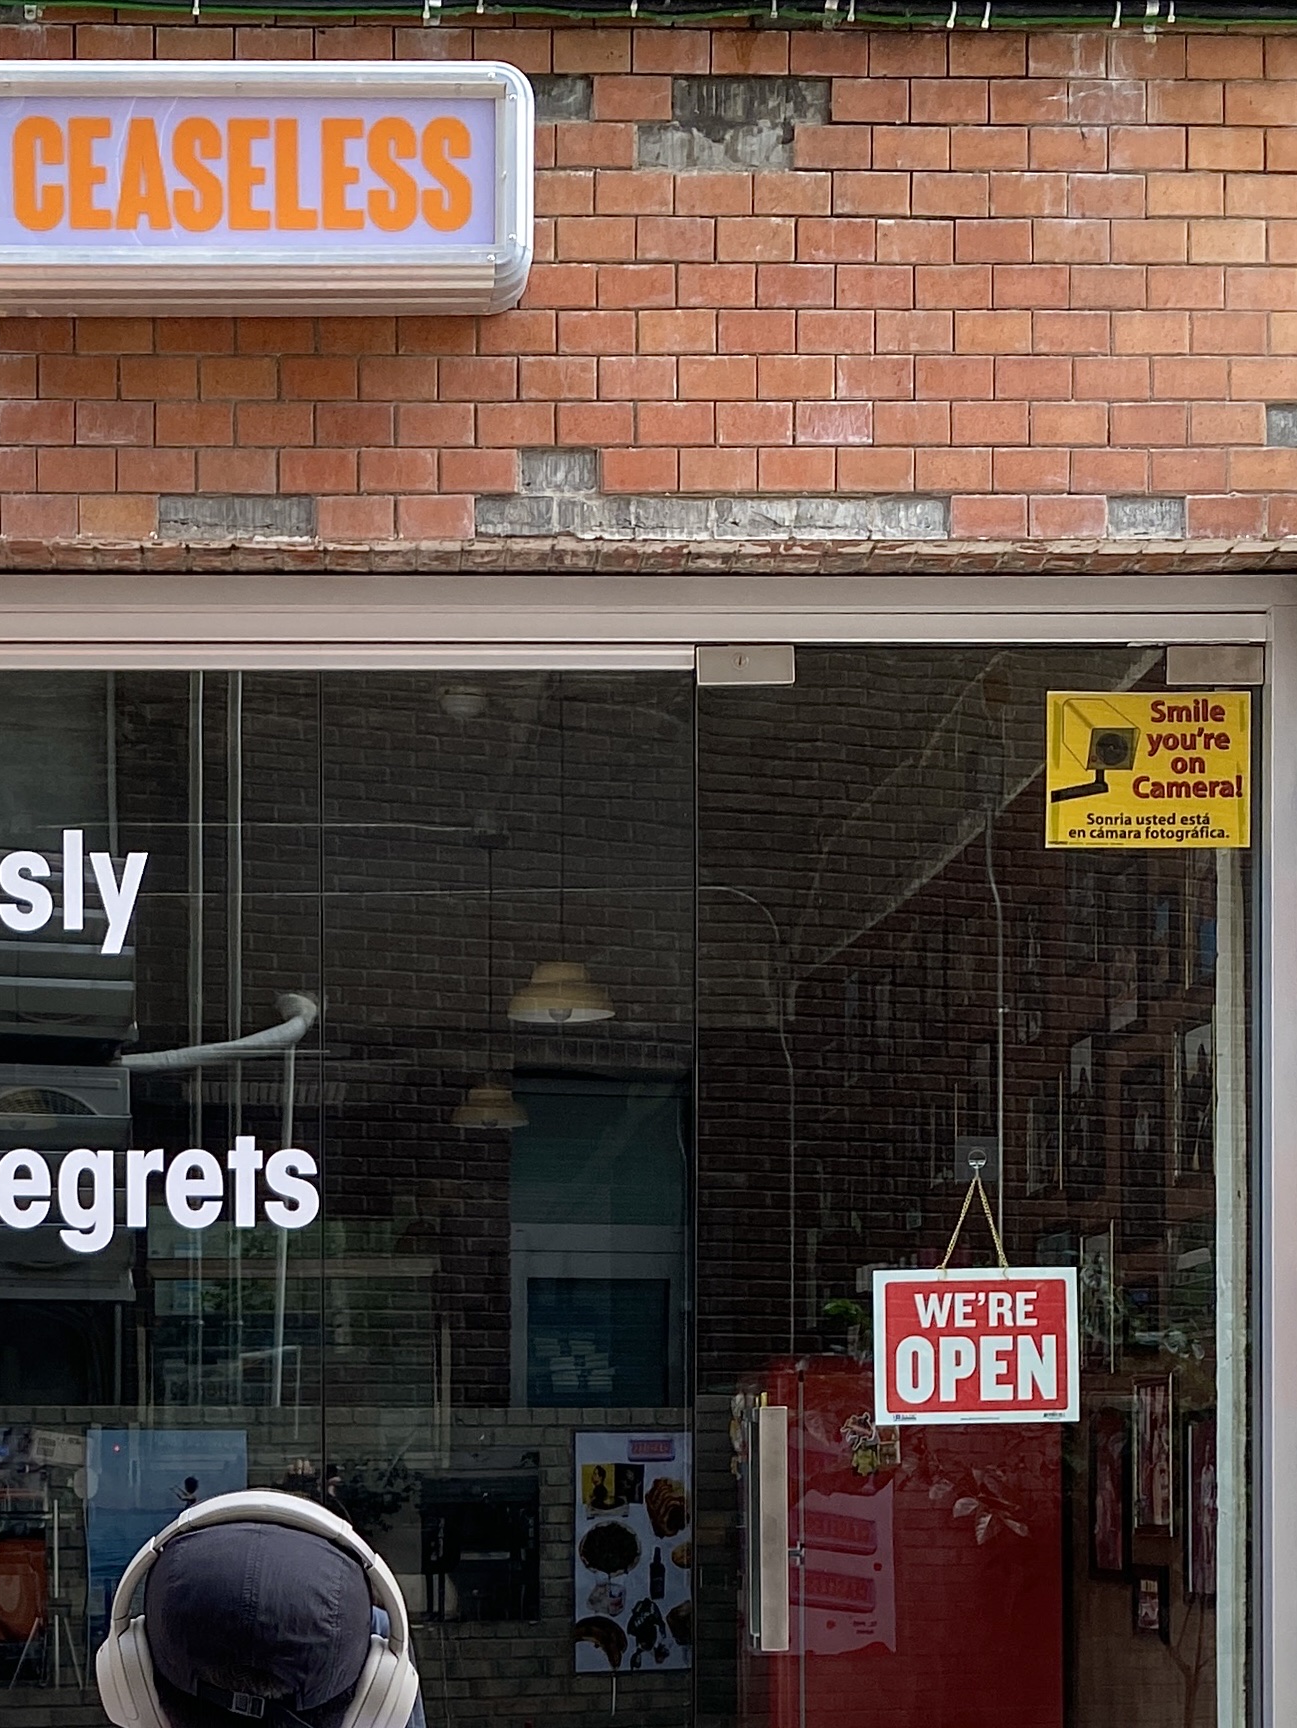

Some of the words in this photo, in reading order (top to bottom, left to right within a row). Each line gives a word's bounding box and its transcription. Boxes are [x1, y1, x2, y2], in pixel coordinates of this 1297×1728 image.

[12, 116, 473, 231] CEASELESS
[1150, 699, 1226, 723] Smile
[1146, 727, 1231, 757] you're
[1170, 757, 1206, 774] on
[1132, 775, 1244, 799] Camera!
[1136, 812, 1176, 826] usted
[1180, 812, 1211, 826] está
[1068, 828, 1086, 839] en
[1089, 826, 1142, 840] cámara
[1144, 826, 1230, 843] fotográfica.
[914, 1291, 1038, 1328] WE'RE
[895, 1334, 1058, 1404] OPEN
